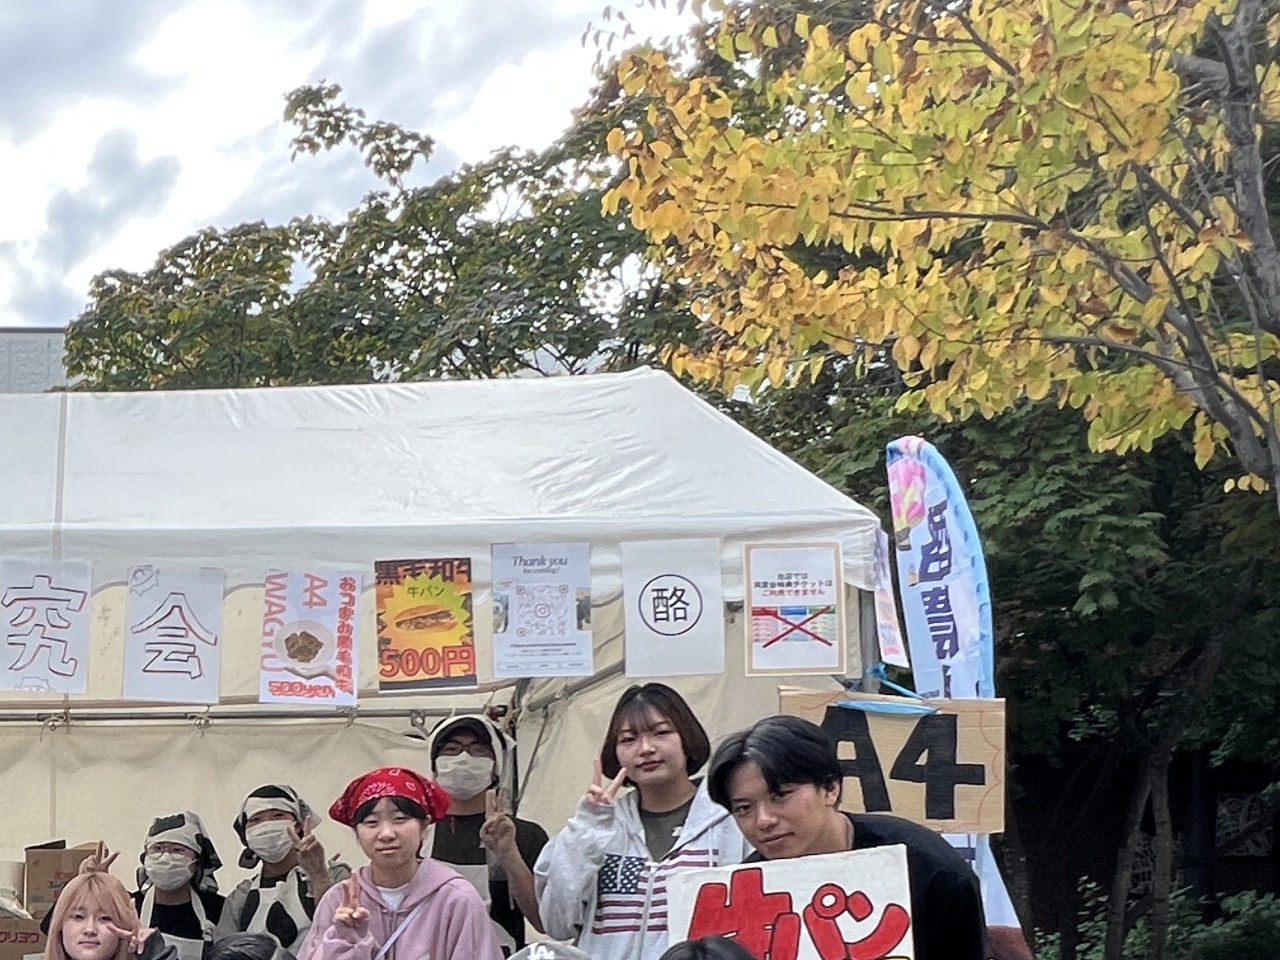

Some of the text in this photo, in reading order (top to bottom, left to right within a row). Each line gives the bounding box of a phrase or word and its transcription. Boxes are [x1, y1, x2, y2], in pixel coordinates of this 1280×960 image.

[511, 555, 568, 569] Thank you
[303, 573, 329, 610] A4
[407, 585, 445, 598] 牛パン
[651, 586, 690, 624] 酪
[260, 571, 289, 673] WAGYU
[379, 644, 476, 678] 500円
[819, 705, 986, 820] A4
